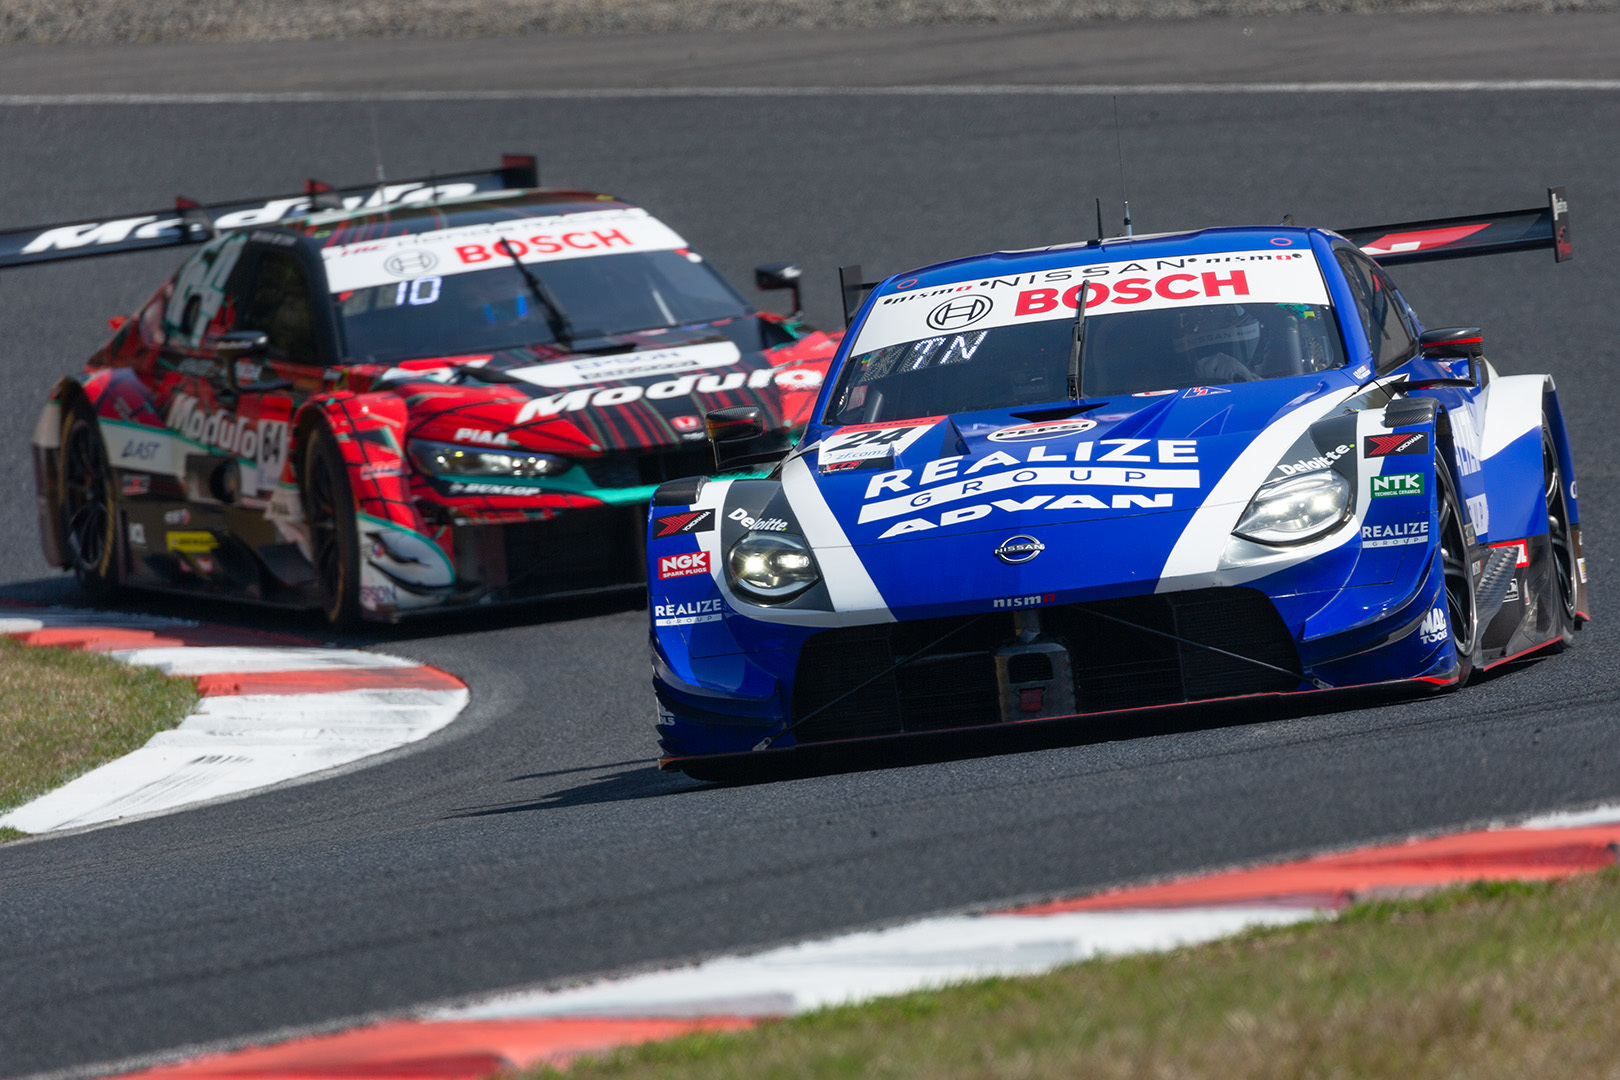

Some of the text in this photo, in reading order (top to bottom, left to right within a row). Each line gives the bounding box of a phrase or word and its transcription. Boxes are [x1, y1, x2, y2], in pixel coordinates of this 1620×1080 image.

[455, 229, 632, 264] BOSCH
[891, 254, 1292, 305] nismo NISSAN nismo
[396, 276, 441, 305] 10
[1014, 269, 1250, 317] BOSCH
[514, 368, 824, 424] Modulo
[166, 393, 258, 459] Modulo
[454, 427, 509, 445] PIAA
[996, 423, 1090, 438] PEPSI
[262, 423, 284, 465] 64
[825, 426, 919, 453] 24
[1395, 433, 1425, 452] YOKOHAMA
[865, 439, 1199, 499] REALIZE
[463, 483, 542, 496] DUNLOP
[911, 470, 1147, 507] GROUP
[1374, 474, 1420, 491] NTK
[682, 511, 712, 531] YOKOHAMA
[877, 493, 1174, 539] ADVAN
[1362, 521, 1430, 538] REALIZE
[994, 543, 1046, 555] NISSAN
[1372, 537, 1420, 547] GROUP
[662, 552, 707, 572] NGK
[663, 567, 707, 578] SPARK PLUGS
[655, 599, 722, 617] REALIZE
[993, 593, 1056, 608] nismo
[666, 615, 713, 625] GROUP
